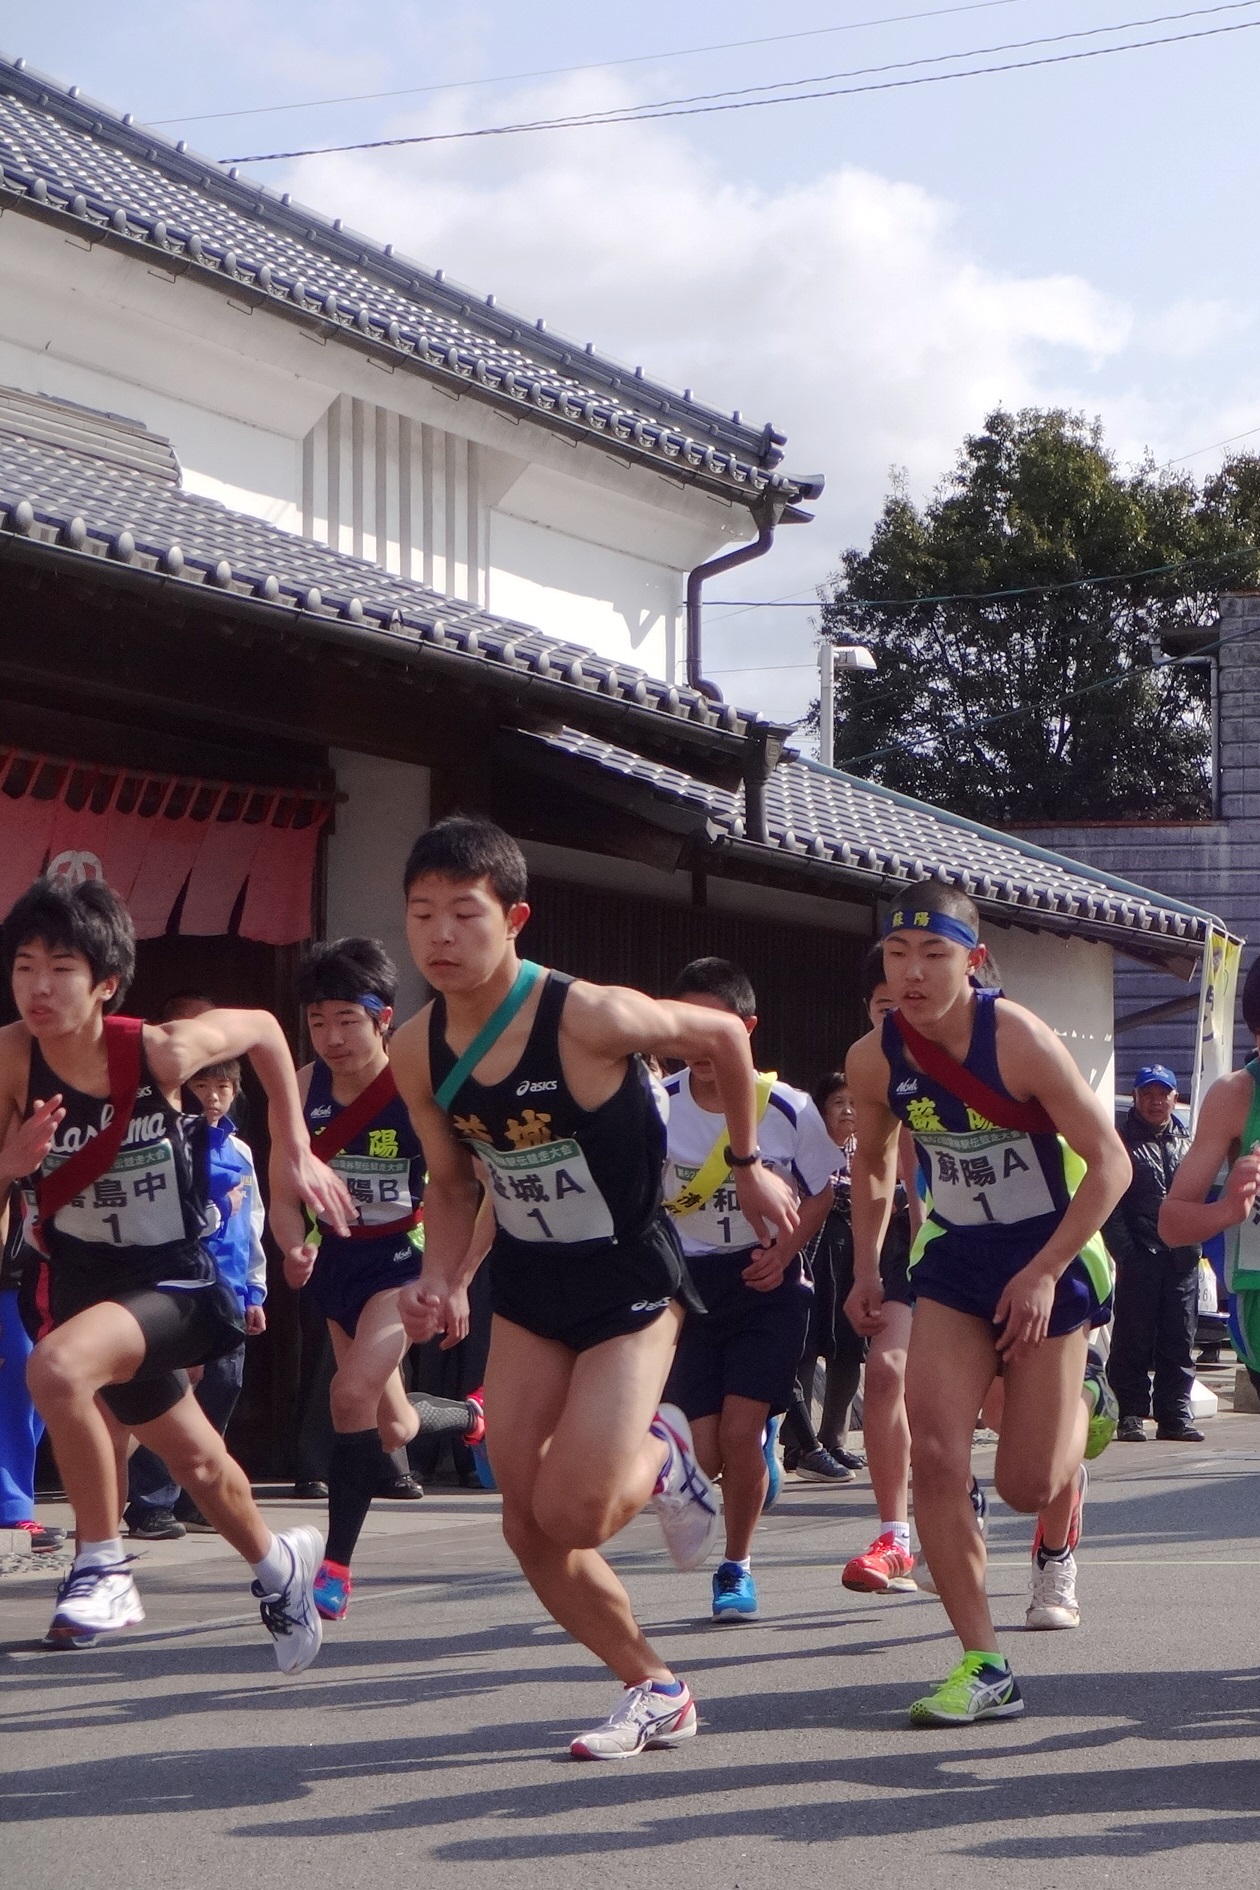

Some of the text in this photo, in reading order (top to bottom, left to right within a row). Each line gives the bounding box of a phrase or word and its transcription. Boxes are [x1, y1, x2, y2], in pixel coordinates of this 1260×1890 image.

[973, 1192, 995, 1221] 1
[102, 1213, 122, 1243] 1
[526, 1207, 554, 1239] 1
[717, 1216, 731, 1243] 1
